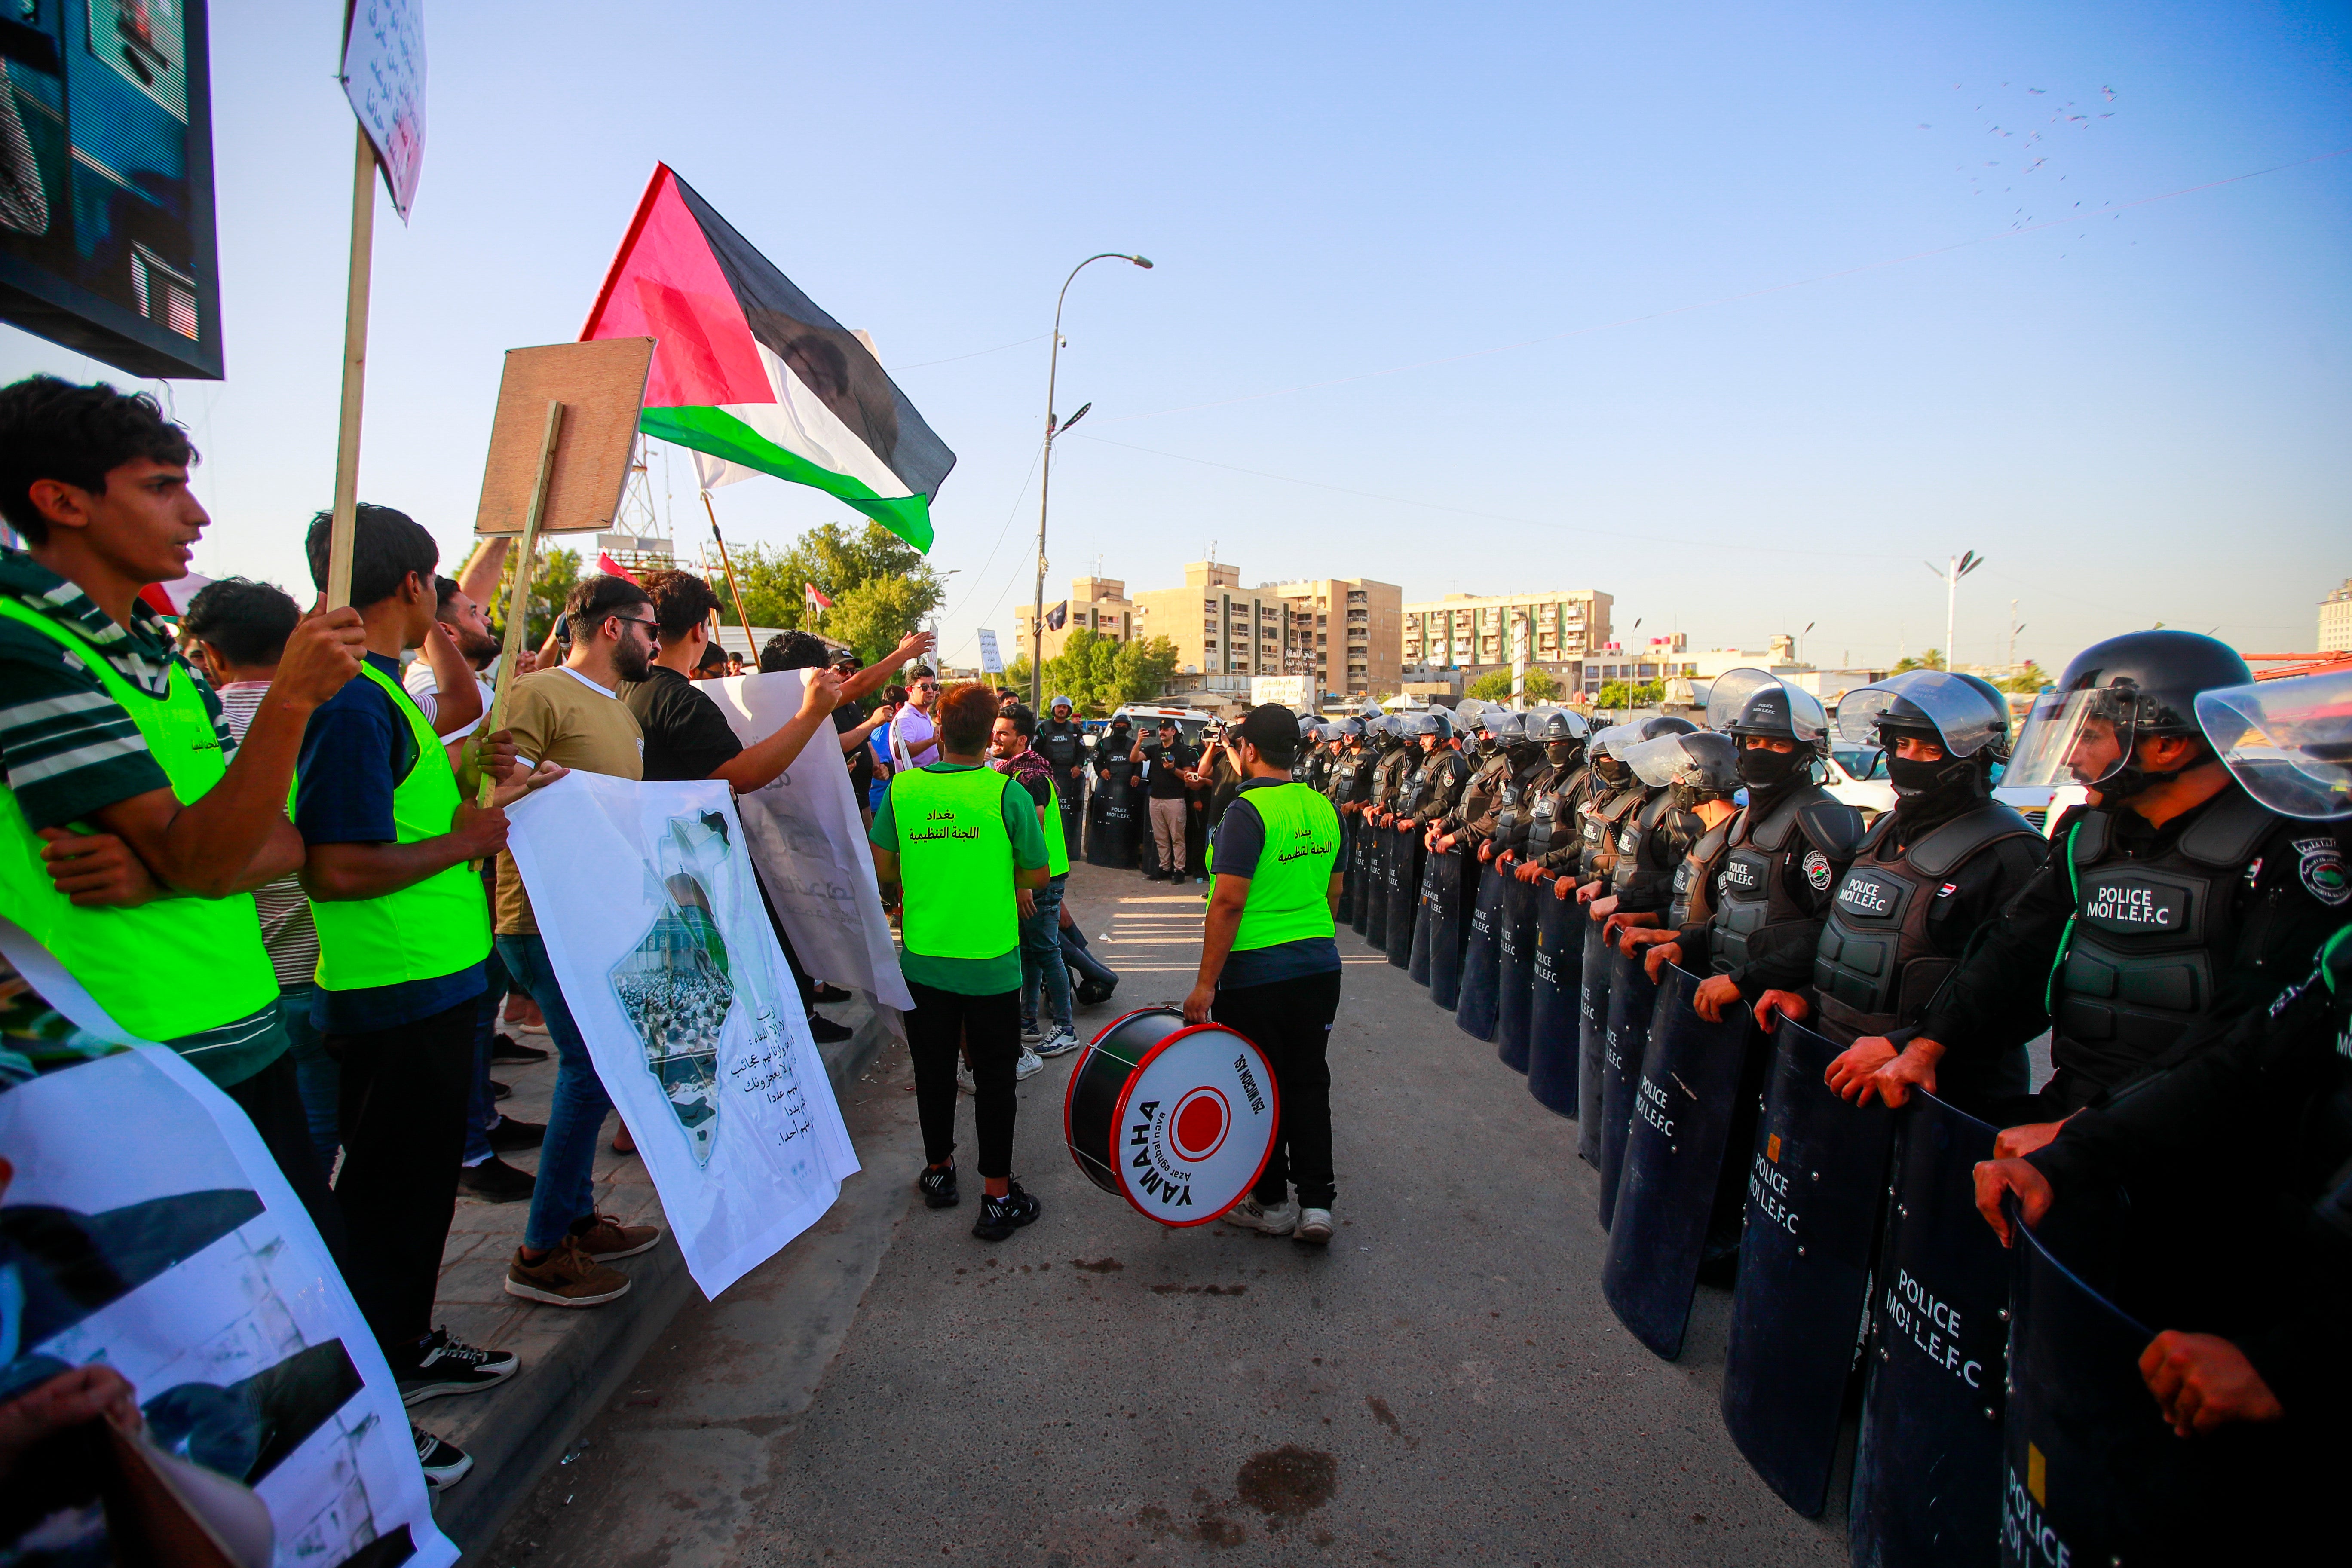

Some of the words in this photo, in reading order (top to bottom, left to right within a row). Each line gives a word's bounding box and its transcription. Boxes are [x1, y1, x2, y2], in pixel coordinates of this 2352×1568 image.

[926, 809, 955, 823] بغداد
[909, 827, 949, 844] التنظيمية
[952, 826, 979, 842] اللجنة
[1729, 862, 1748, 875] POLICE
[1734, 873, 1754, 886] L.E.F.C
[1848, 879, 1880, 897] POLICE
[2098, 887, 2152, 906] POLICE
[1839, 889, 1856, 902] MOI
[1854, 893, 1886, 911] L.E.F.C
[2087, 902, 2113, 918] MOI
[2117, 904, 2169, 924] L.E.F.C
[731, 1054, 760, 1078] عجائب
[1233, 1053, 1249, 1073] ASL
[1239, 1068, 1260, 1102] MICRON
[1642, 1075, 1668, 1109] POLICE
[767, 1091, 784, 1104] عددا
[1251, 1097, 1265, 1115] 250
[784, 1105, 801, 1117] بددا
[1644, 1103, 1674, 1137] L.E.F.C
[1154, 1112, 1166, 1139] nava
[1130, 1101, 1192, 1207] YAMAHA
[1152, 1140, 1170, 1172] eghbal
[1170, 1169, 1192, 1182] Azar
[1755, 1152, 1788, 1198] POLICE
[1761, 1188, 1798, 1234] L.E.F.C
[1899, 1268, 1961, 1338] POLICE
[1886, 1288, 1910, 1334] MOI
[1914, 1320, 1981, 1388] L.E.F.C
